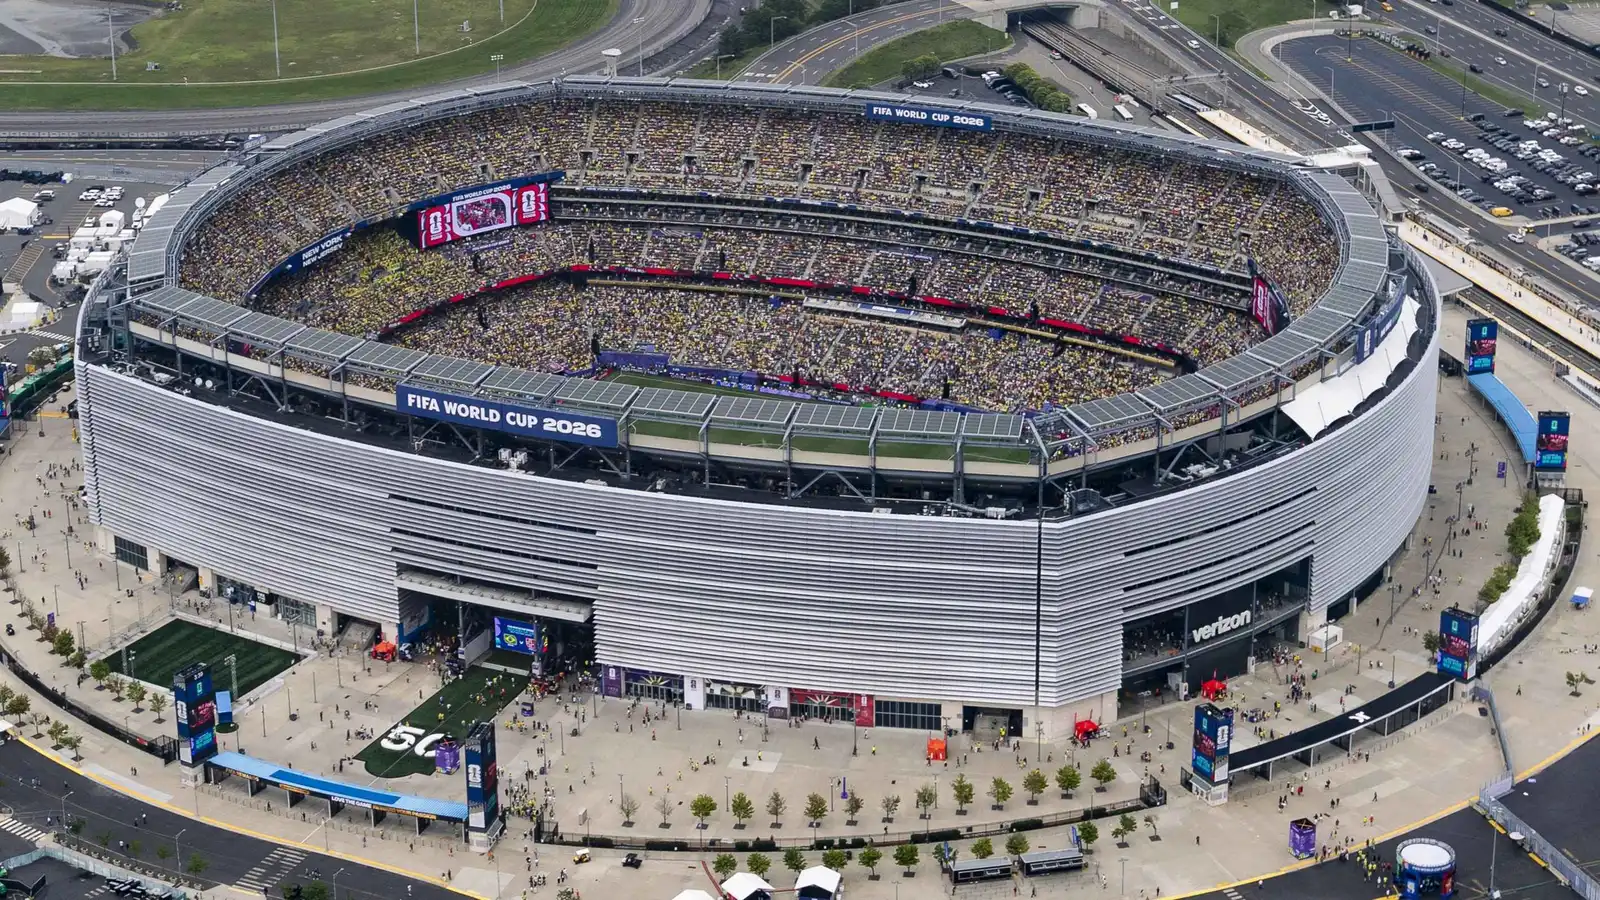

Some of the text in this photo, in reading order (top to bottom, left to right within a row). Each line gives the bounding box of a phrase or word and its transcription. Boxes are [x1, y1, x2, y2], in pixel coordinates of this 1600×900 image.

[873, 107, 984, 126] FIFA WORLD CUP 2026
[464, 190, 483, 199] WORLD
[302, 235, 343, 260] NEW YORK
[302, 243, 343, 267] NEW JERSEY
[407, 393, 602, 438] FIFA WORLD CUP 2026
[1192, 610, 1251, 643] verizon
